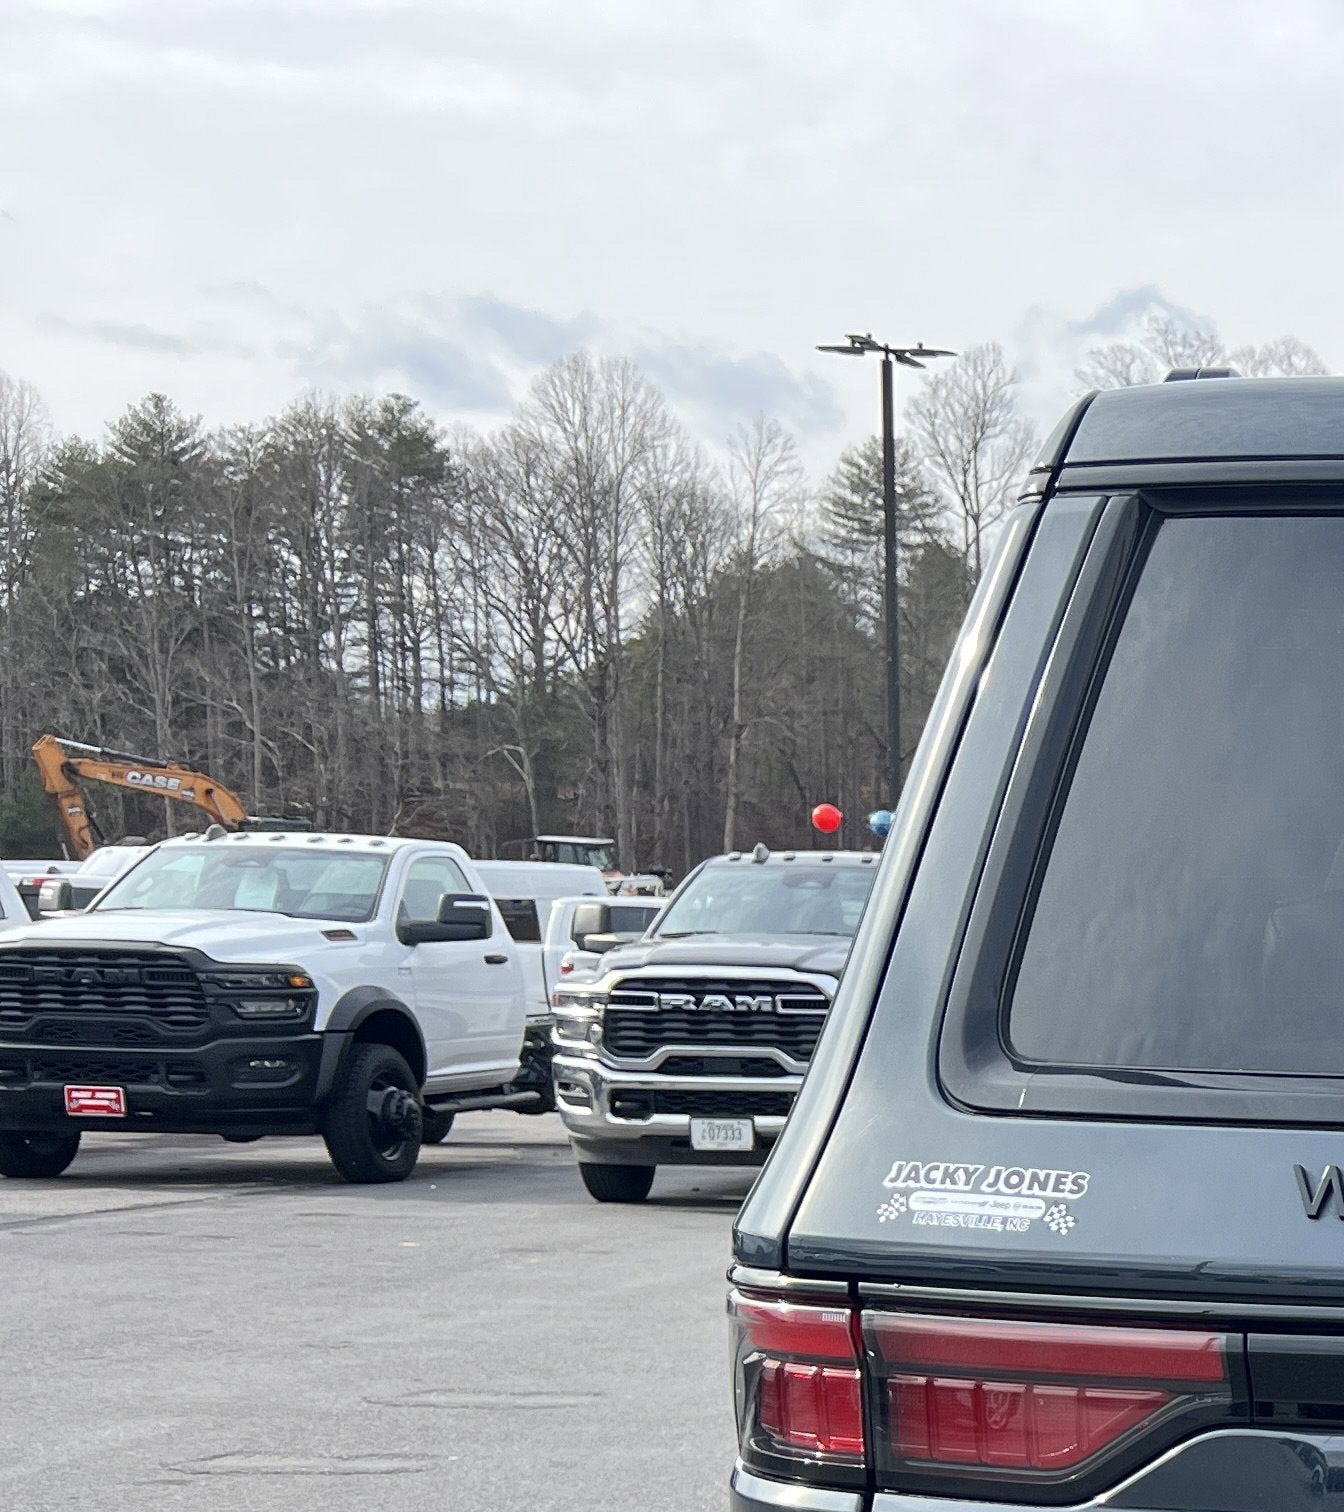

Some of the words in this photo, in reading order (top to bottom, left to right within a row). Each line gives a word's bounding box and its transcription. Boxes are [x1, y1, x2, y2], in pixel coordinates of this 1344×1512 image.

[127, 771, 181, 790] CASE
[659, 993, 772, 1011] RAM
[882, 1161, 985, 1191] JACKY
[980, 1165, 1092, 1199] JONES
[1005, 1217, 1031, 1232] NC
